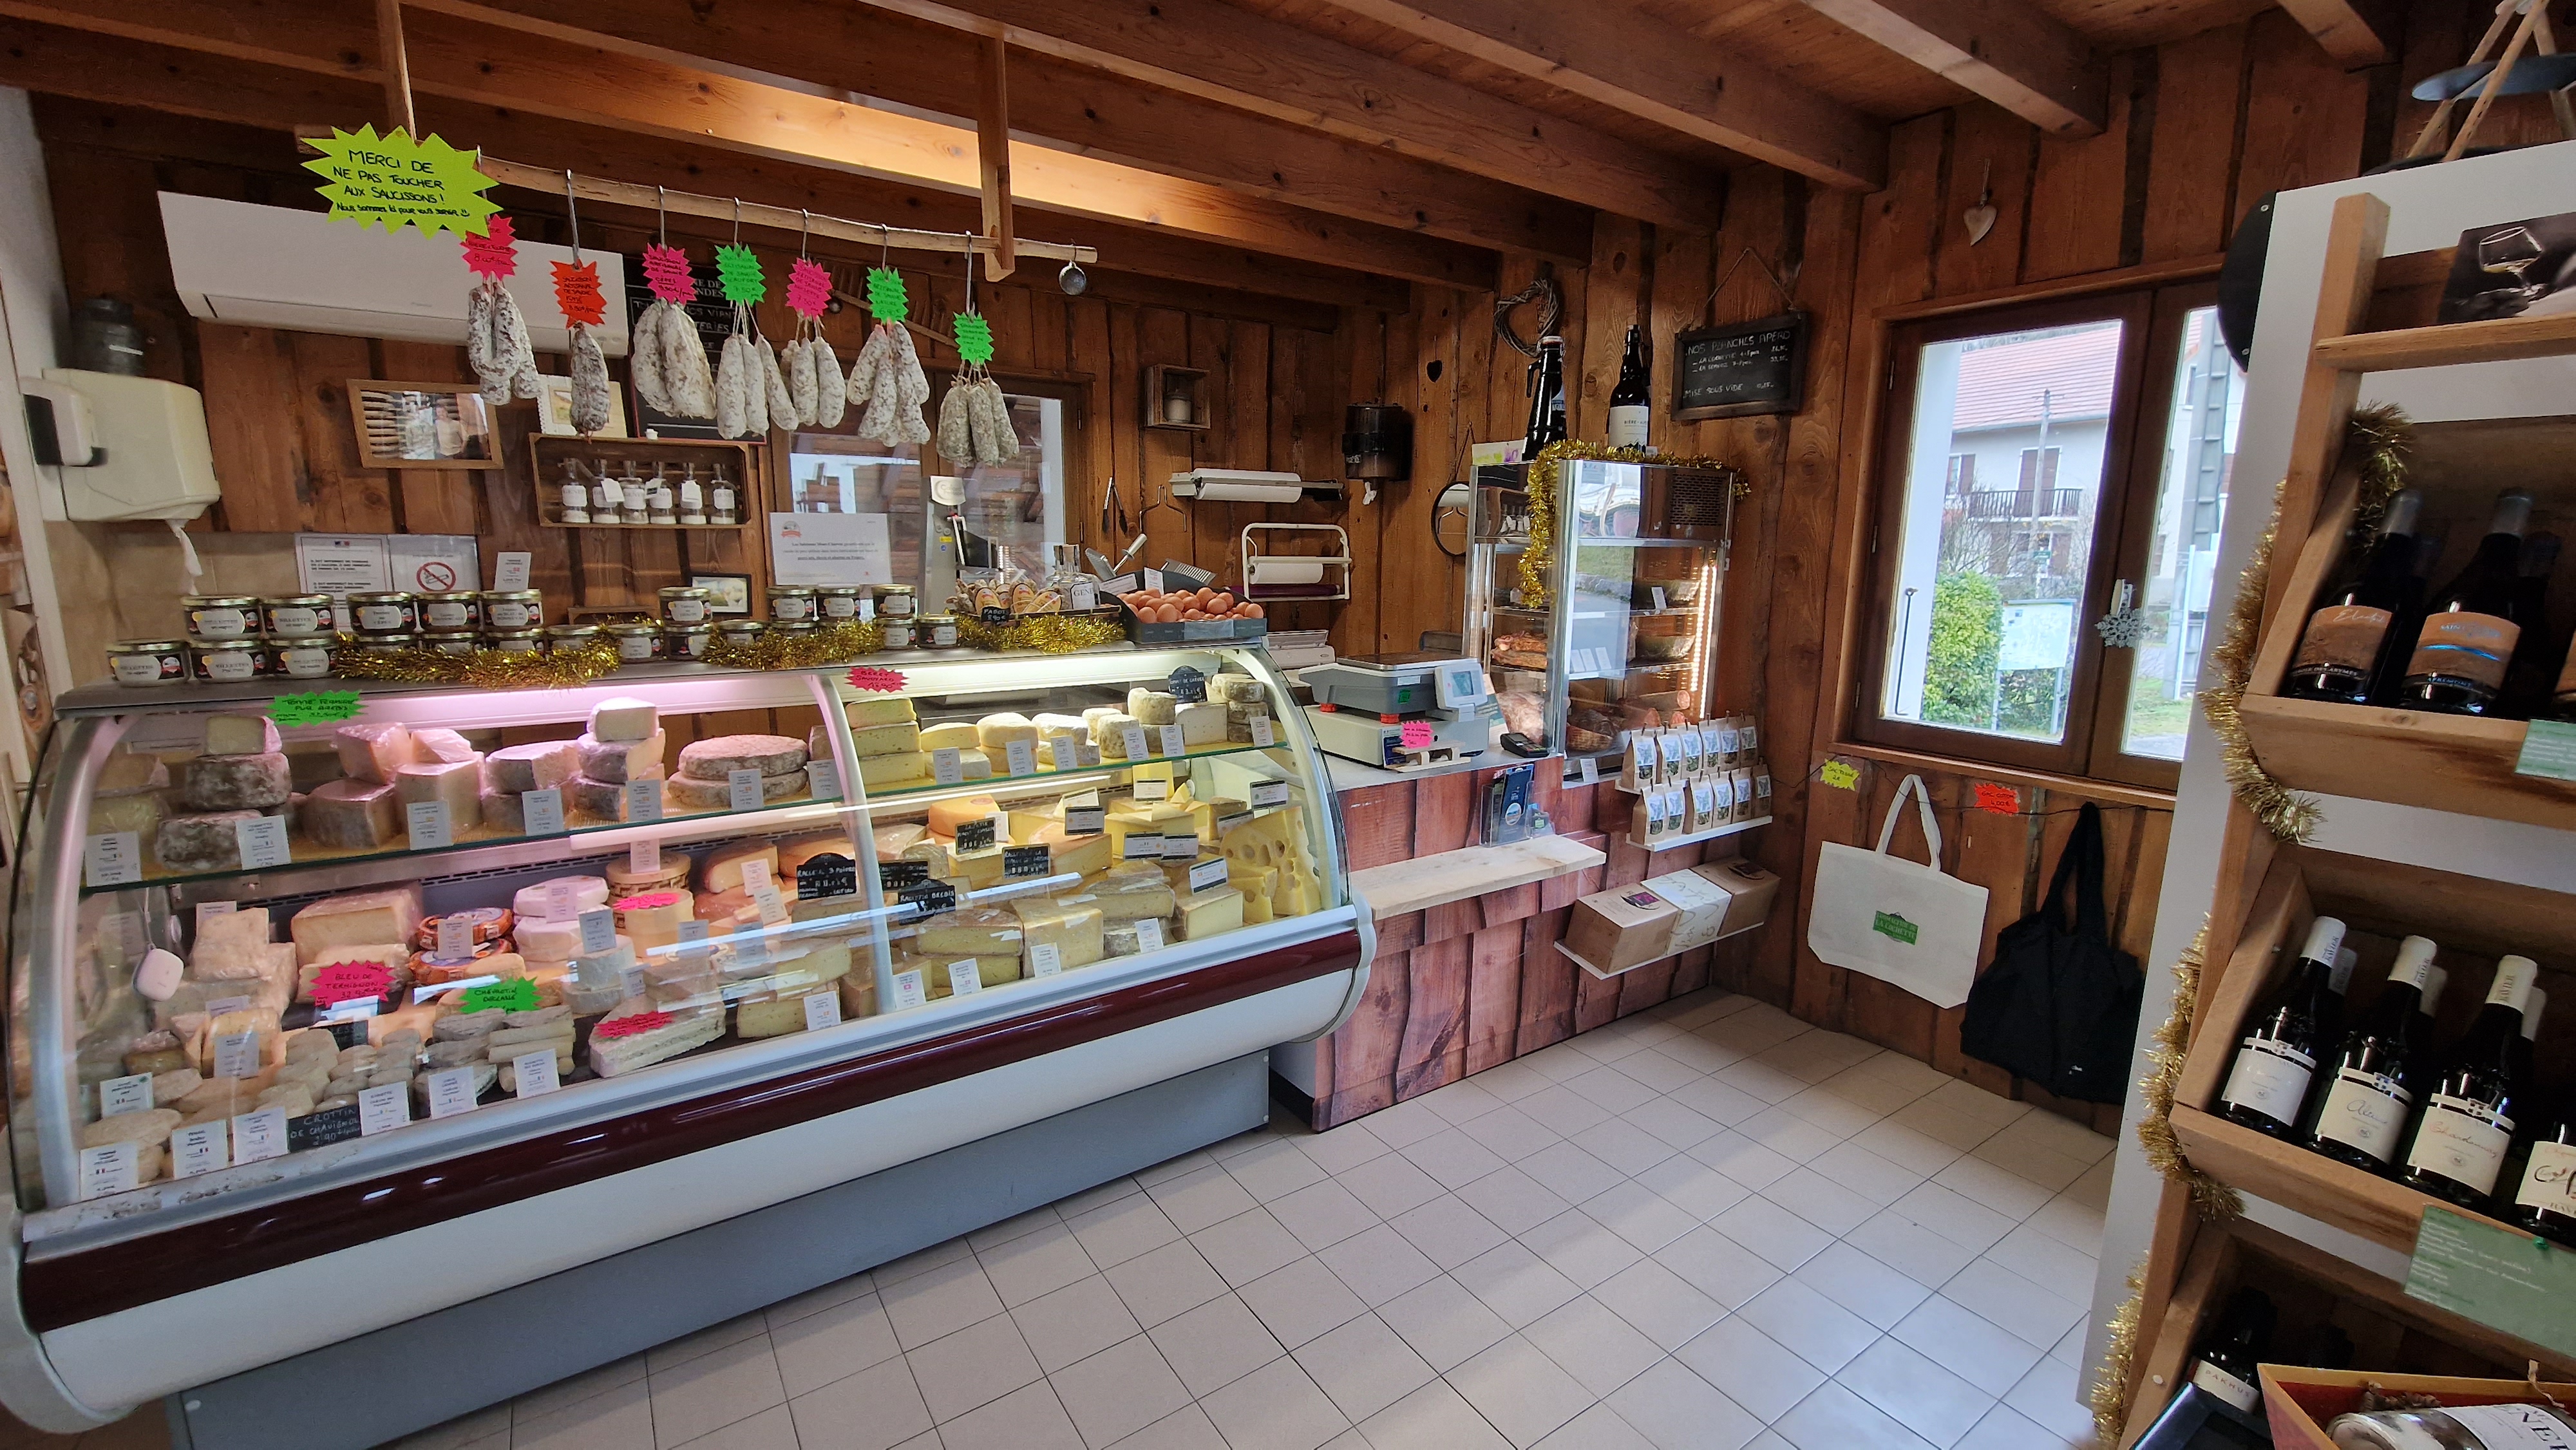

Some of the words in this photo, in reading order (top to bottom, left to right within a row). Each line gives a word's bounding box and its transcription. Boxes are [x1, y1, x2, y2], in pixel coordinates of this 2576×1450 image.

[348, 149, 401, 169] MERCI
[411, 160, 435, 174] DE
[333, 165, 353, 180] NE
[358, 170, 383, 184] PAS
[388, 174, 446, 191] TOUCHER
[343, 185, 366, 197] AUX
[1725, 383, 1743, 392] VIDE
[303, 1109, 356, 1125] CROTTIN
[290, 1129, 305, 1139] DE
